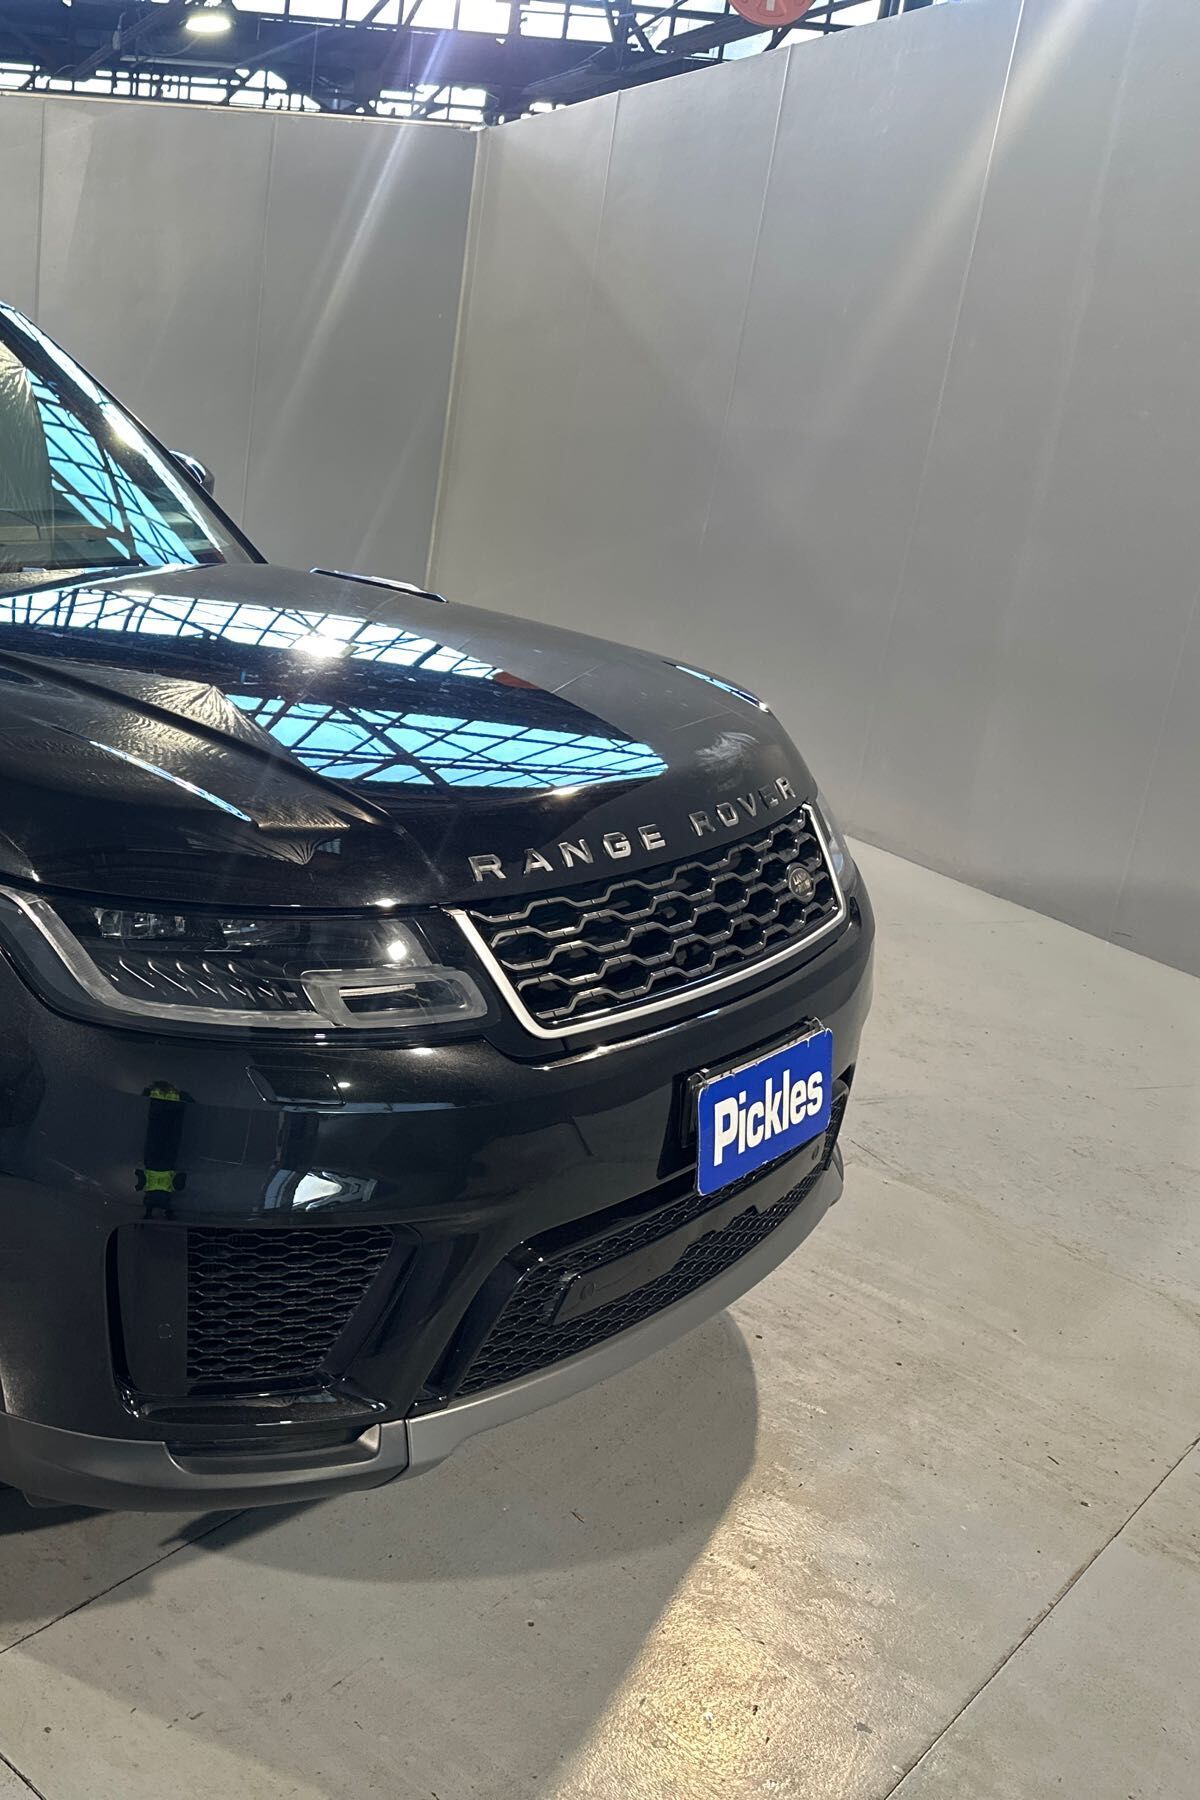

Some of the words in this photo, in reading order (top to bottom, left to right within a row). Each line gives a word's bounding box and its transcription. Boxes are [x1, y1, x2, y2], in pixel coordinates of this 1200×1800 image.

[468, 823, 666, 883] RANGE
[688, 776, 797, 837] ROVER
[713, 1068, 824, 1168] Pickles
